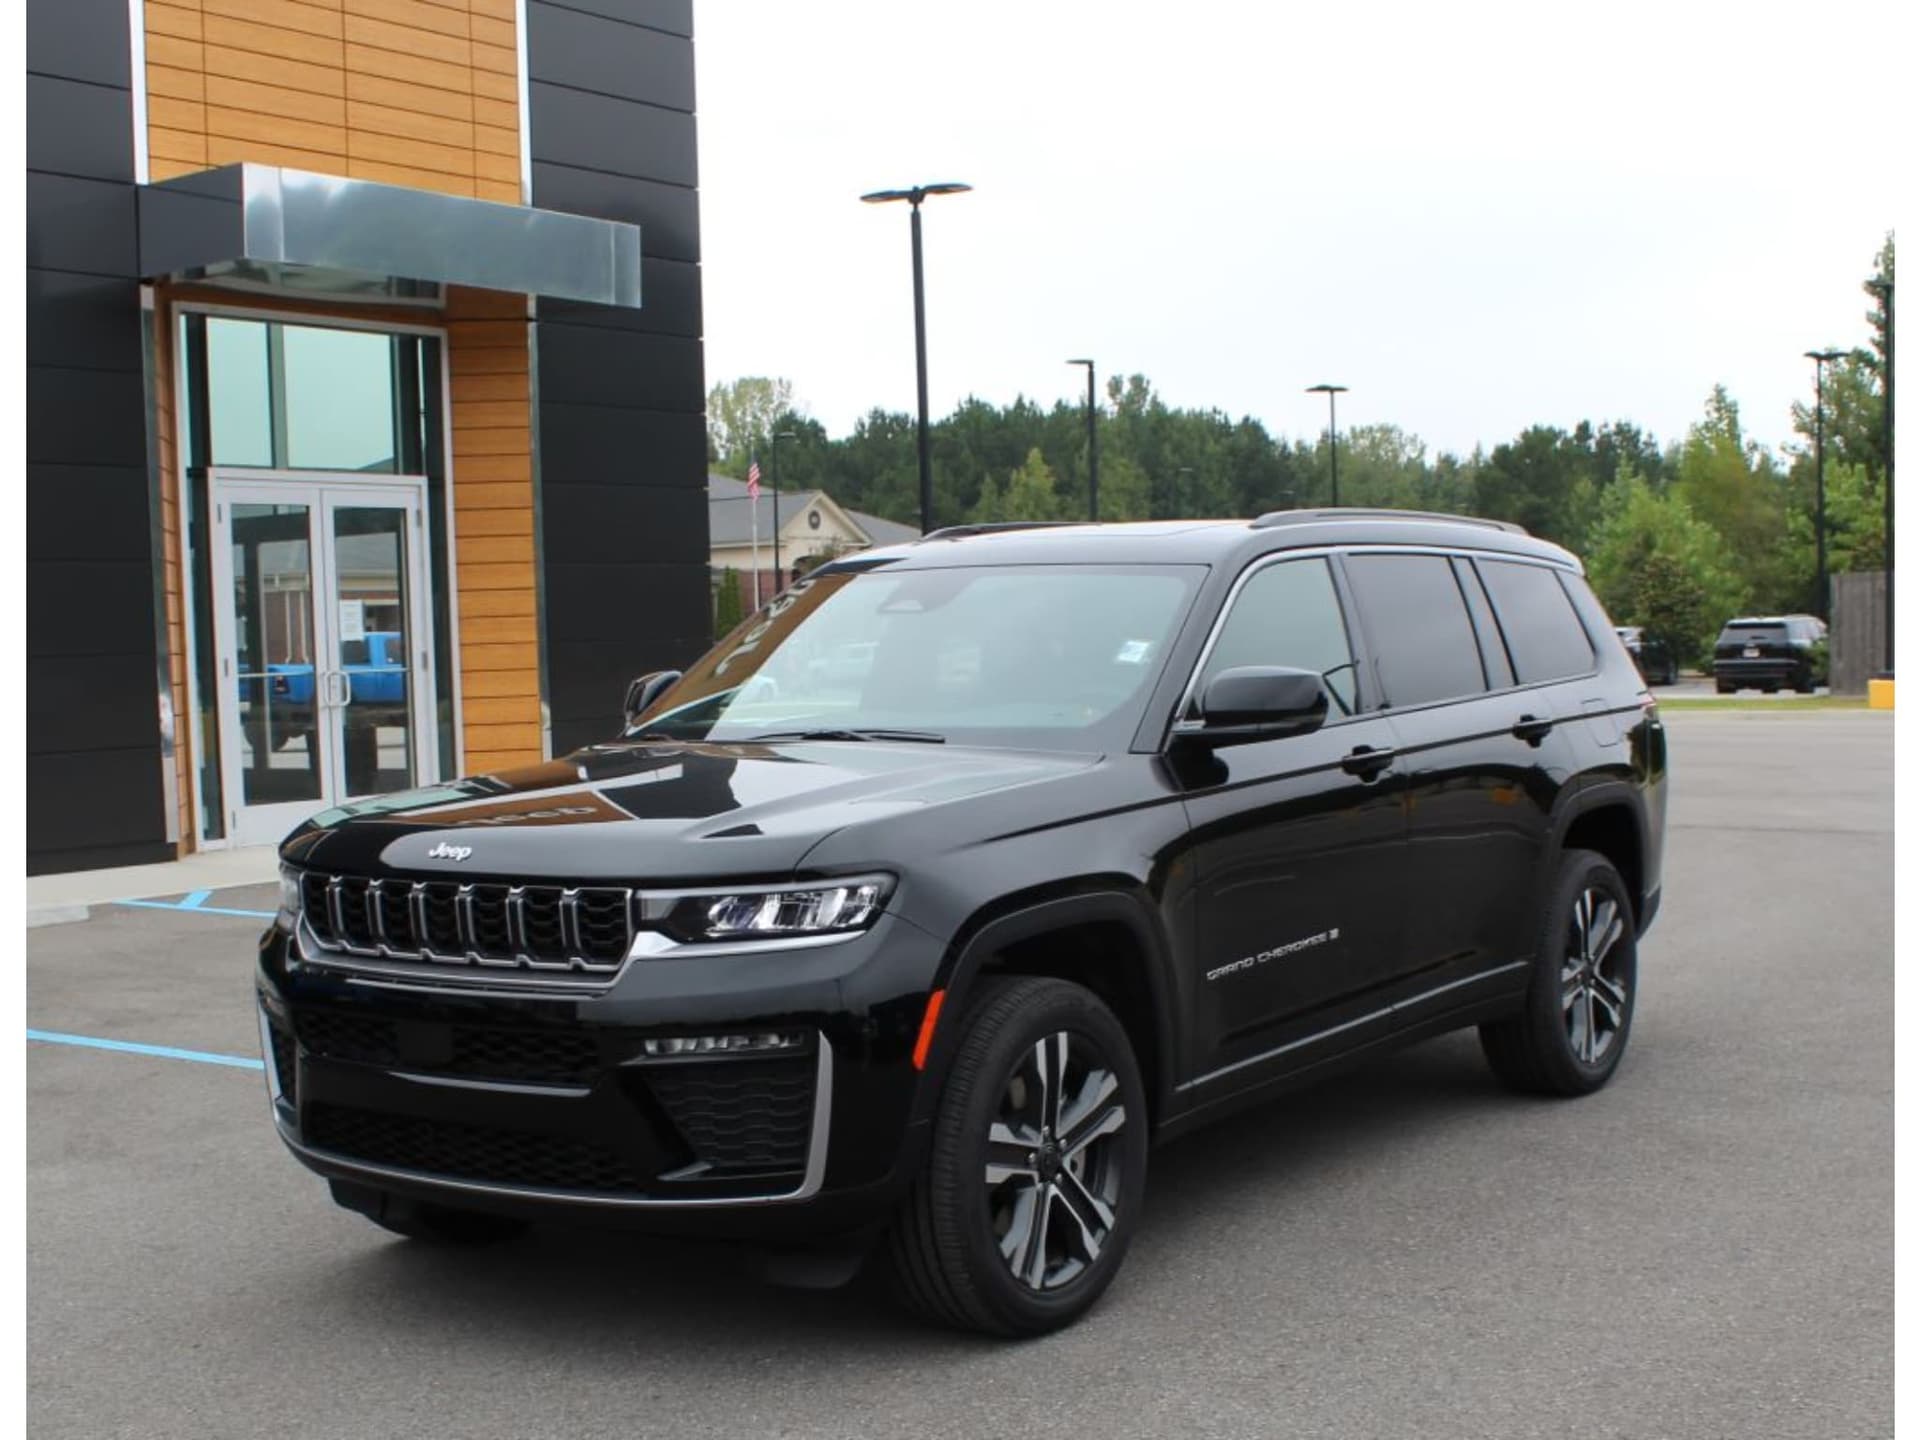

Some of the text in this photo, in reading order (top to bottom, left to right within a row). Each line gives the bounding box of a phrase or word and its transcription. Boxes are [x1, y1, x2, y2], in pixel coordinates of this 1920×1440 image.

[428, 842, 472, 861] Jeep
[1206, 932, 1328, 981] GRAND CHEROKEE
